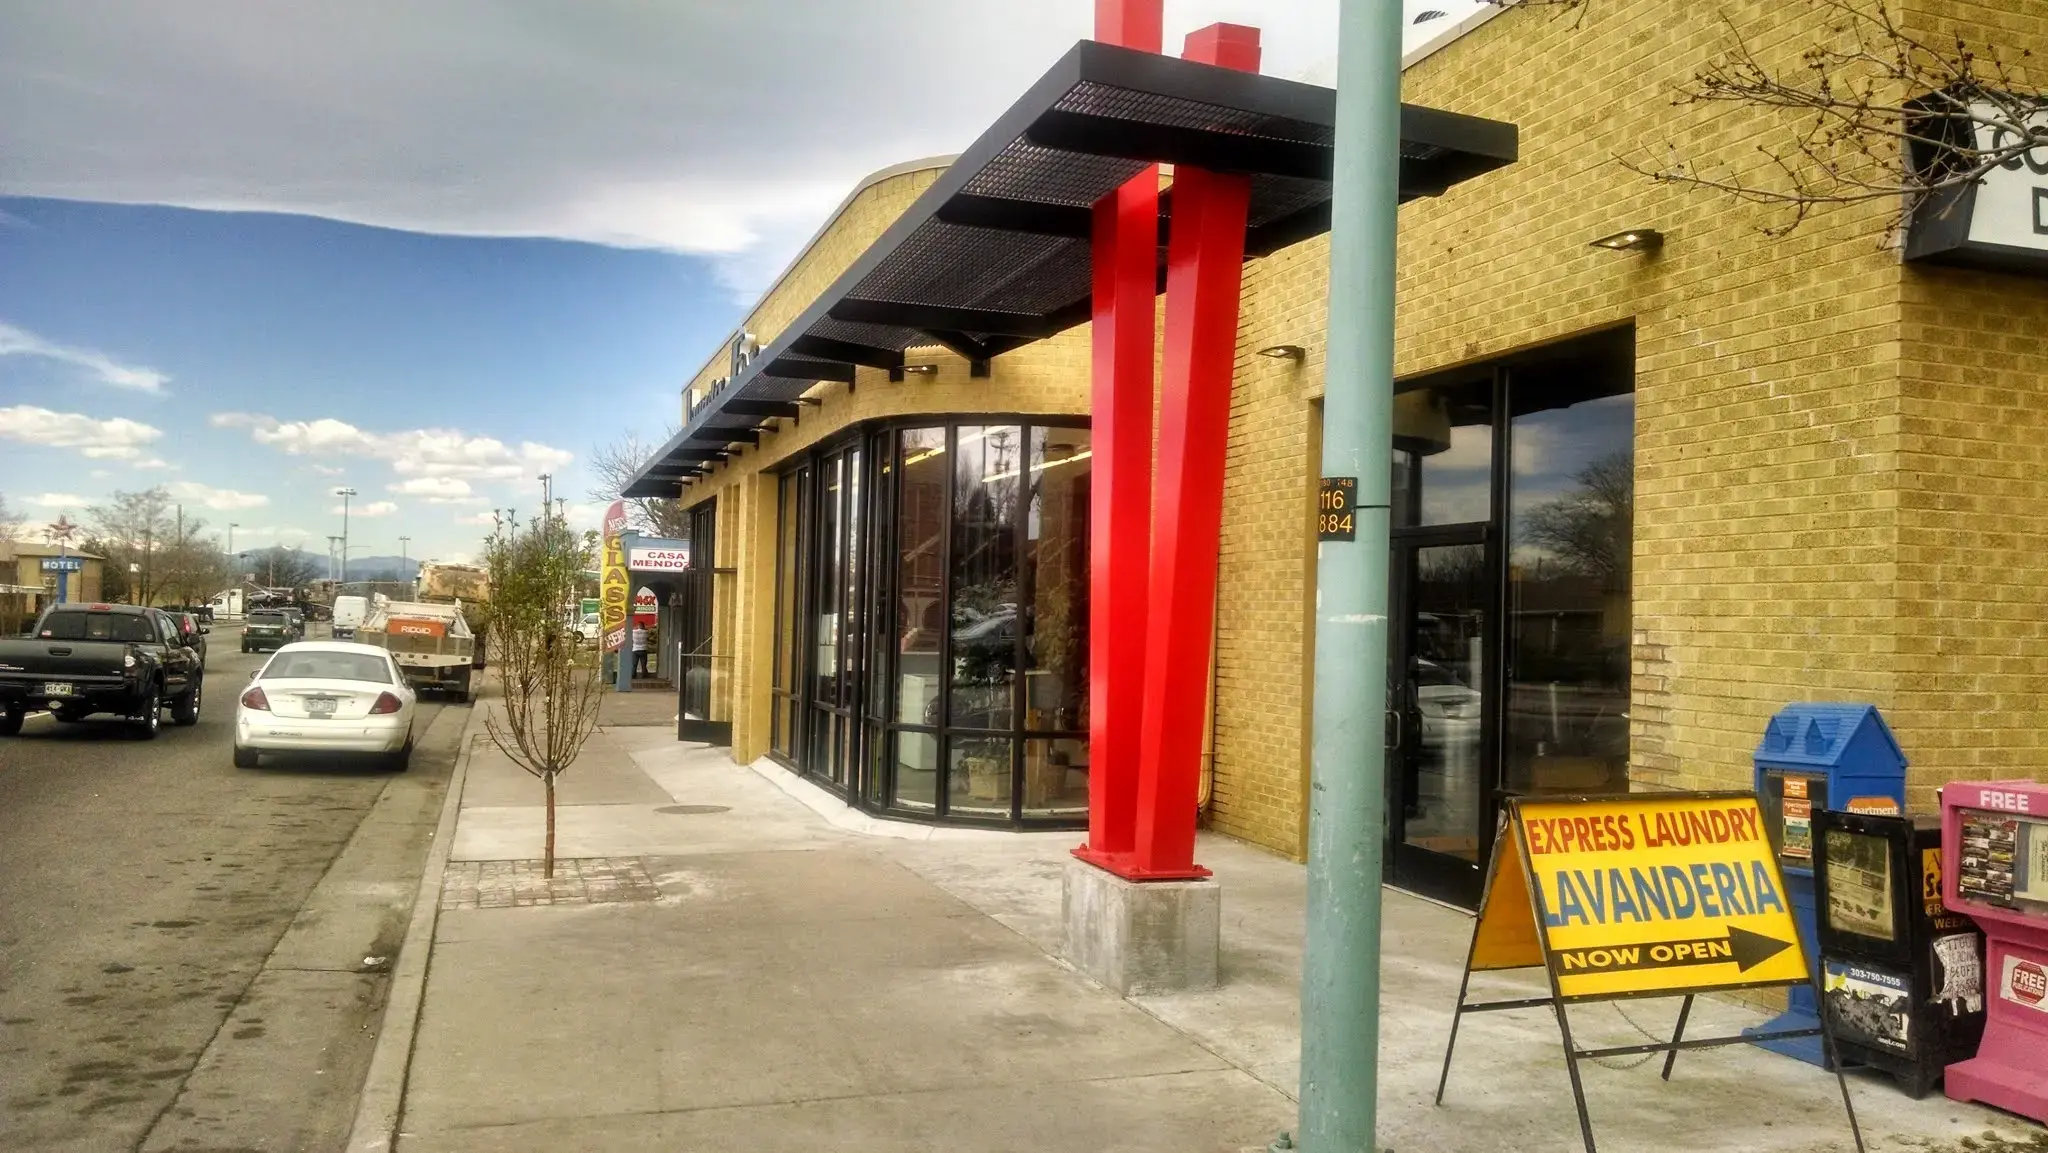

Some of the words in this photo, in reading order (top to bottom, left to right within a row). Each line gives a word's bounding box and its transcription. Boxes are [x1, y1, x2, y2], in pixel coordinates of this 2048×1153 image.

[1320, 490, 1344, 510] 116
[1319, 513, 1353, 533] 884
[647, 551, 685, 560] CASA
[44, 562, 80, 570] MOTEL
[1980, 790, 2029, 811] FREE
[1847, 806, 1898, 816] Apartment
[1526, 814, 1635, 855] EXPRESS
[1639, 807, 1760, 847] LAUNDRY
[1533, 860, 1785, 928] LAVANDERIA
[1562, 946, 1640, 970] NOW
[1649, 940, 1732, 963] OPEN
[1850, 967, 1901, 987] 303-750-7555
[2013, 969, 2046, 990] FREE
